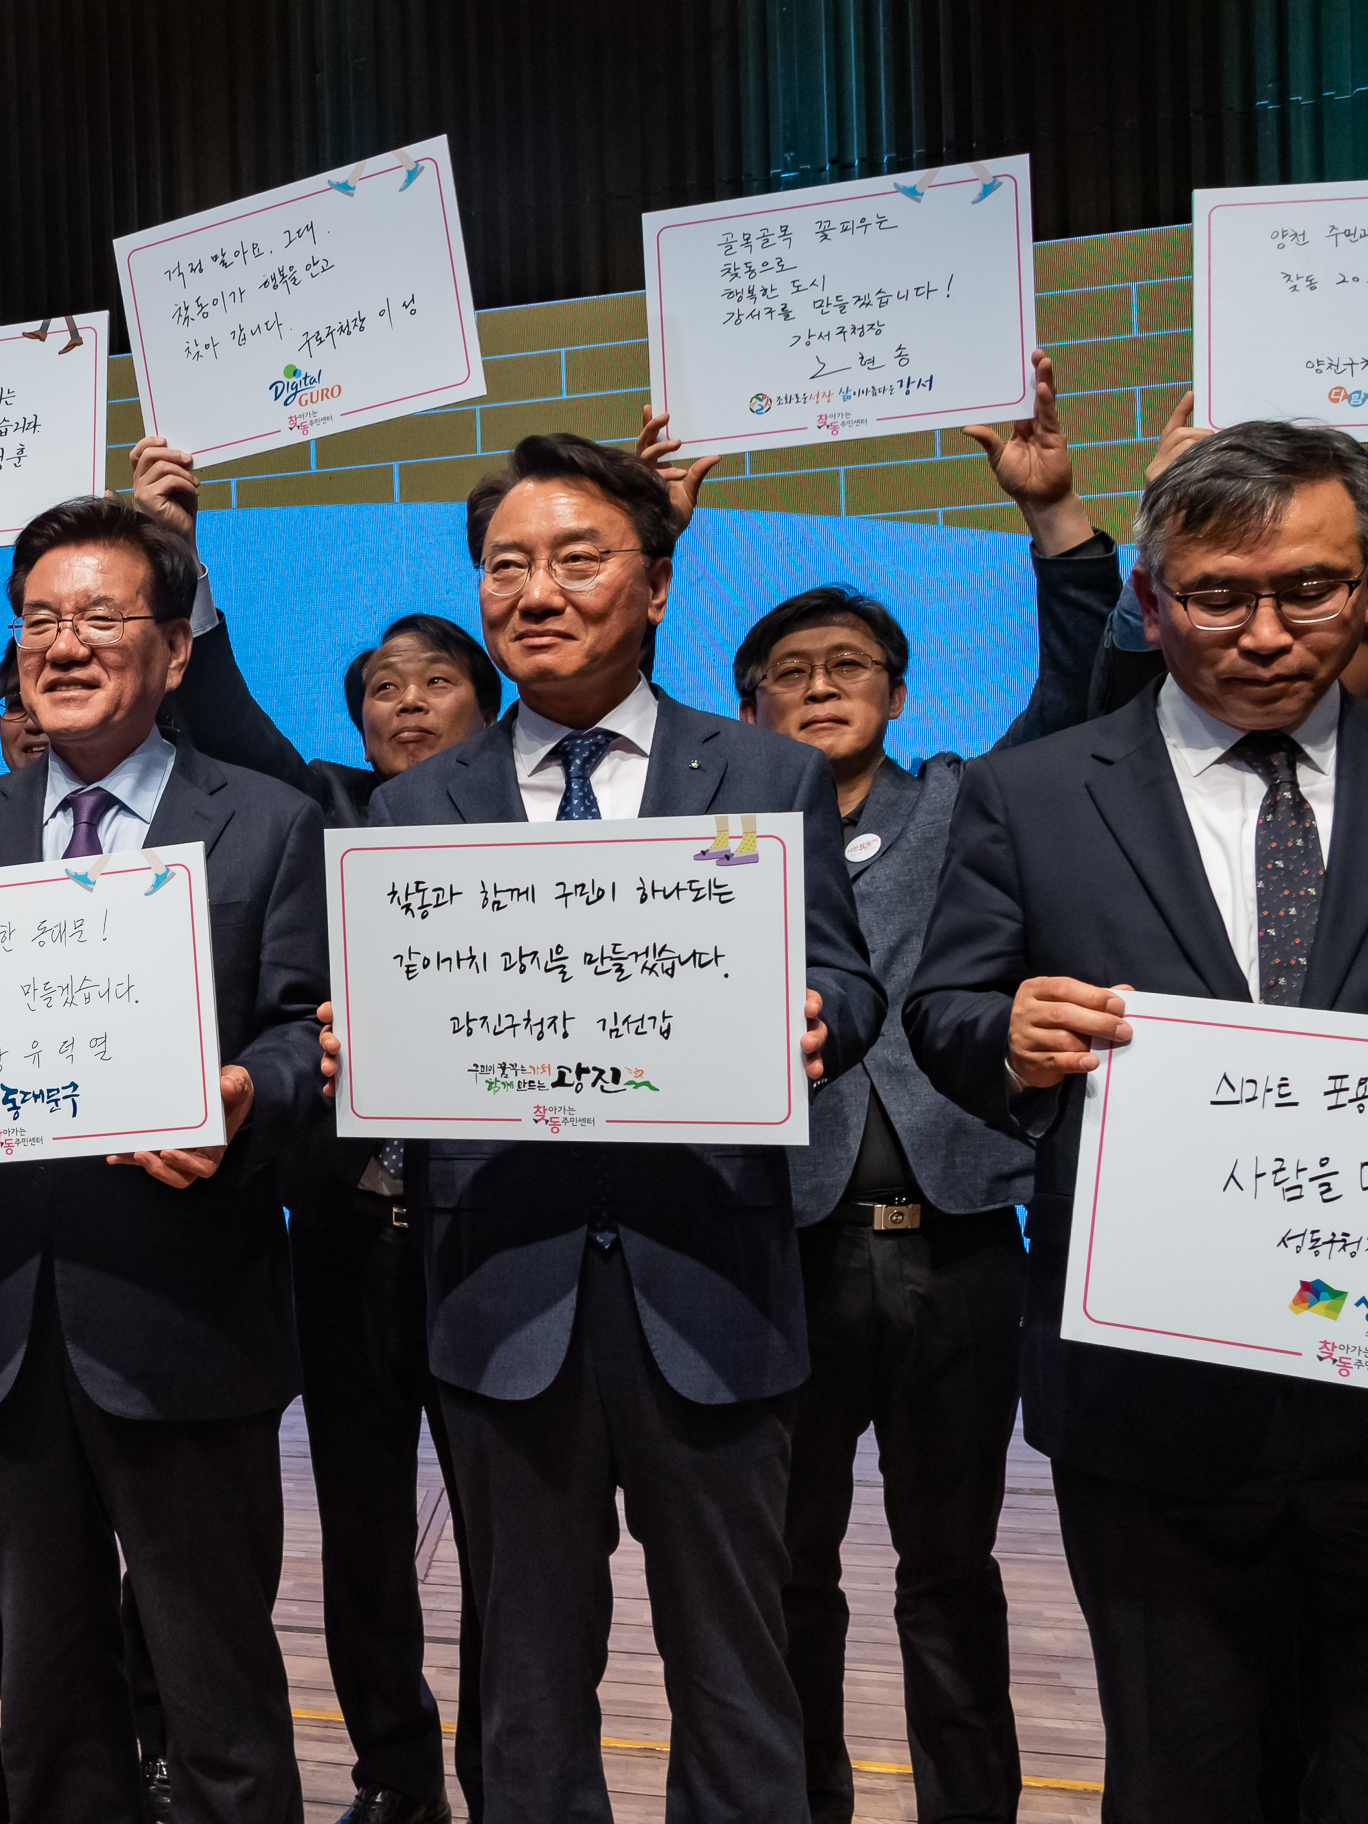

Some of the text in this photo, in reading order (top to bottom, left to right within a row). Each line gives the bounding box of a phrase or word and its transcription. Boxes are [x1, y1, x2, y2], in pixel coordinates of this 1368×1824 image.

[717, 213, 898, 256] 골목골목 꽃피우는
[1271, 228, 1309, 249] 양천
[164, 259, 203, 289] 걱정
[721, 257, 797, 282] 찾동으로
[1281, 272, 1318, 292] 찾동
[172, 256, 334, 327] 찾동이가 행복을 안고
[721, 275, 825, 304] 행복한 도시
[723, 303, 795, 325] 강서구를
[185, 336, 219, 361] 찾아
[298, 311, 366, 358] 구로구청장
[790, 320, 885, 347] 강서구청장
[268, 369, 322, 406] Digital
[298, 384, 342, 406] GURO
[897, 375, 933, 395] 강서
[387, 877, 735, 920] 찾동과 함께 구민이 하나되는
[393, 942, 729, 983] 같이가치 광진을 만들겠습니다.
[450, 1009, 673, 1041] 광진구청장 김선갑
[485, 1077, 514, 1095] 함께
[551, 1062, 626, 1094] 광진
[1210, 1072, 1299, 1108] 스마트
[0, 1081, 80, 1120] 동대문구
[1223, 1156, 1343, 1203] 사람을
[1277, 1229, 1368, 1260] 성동구청
